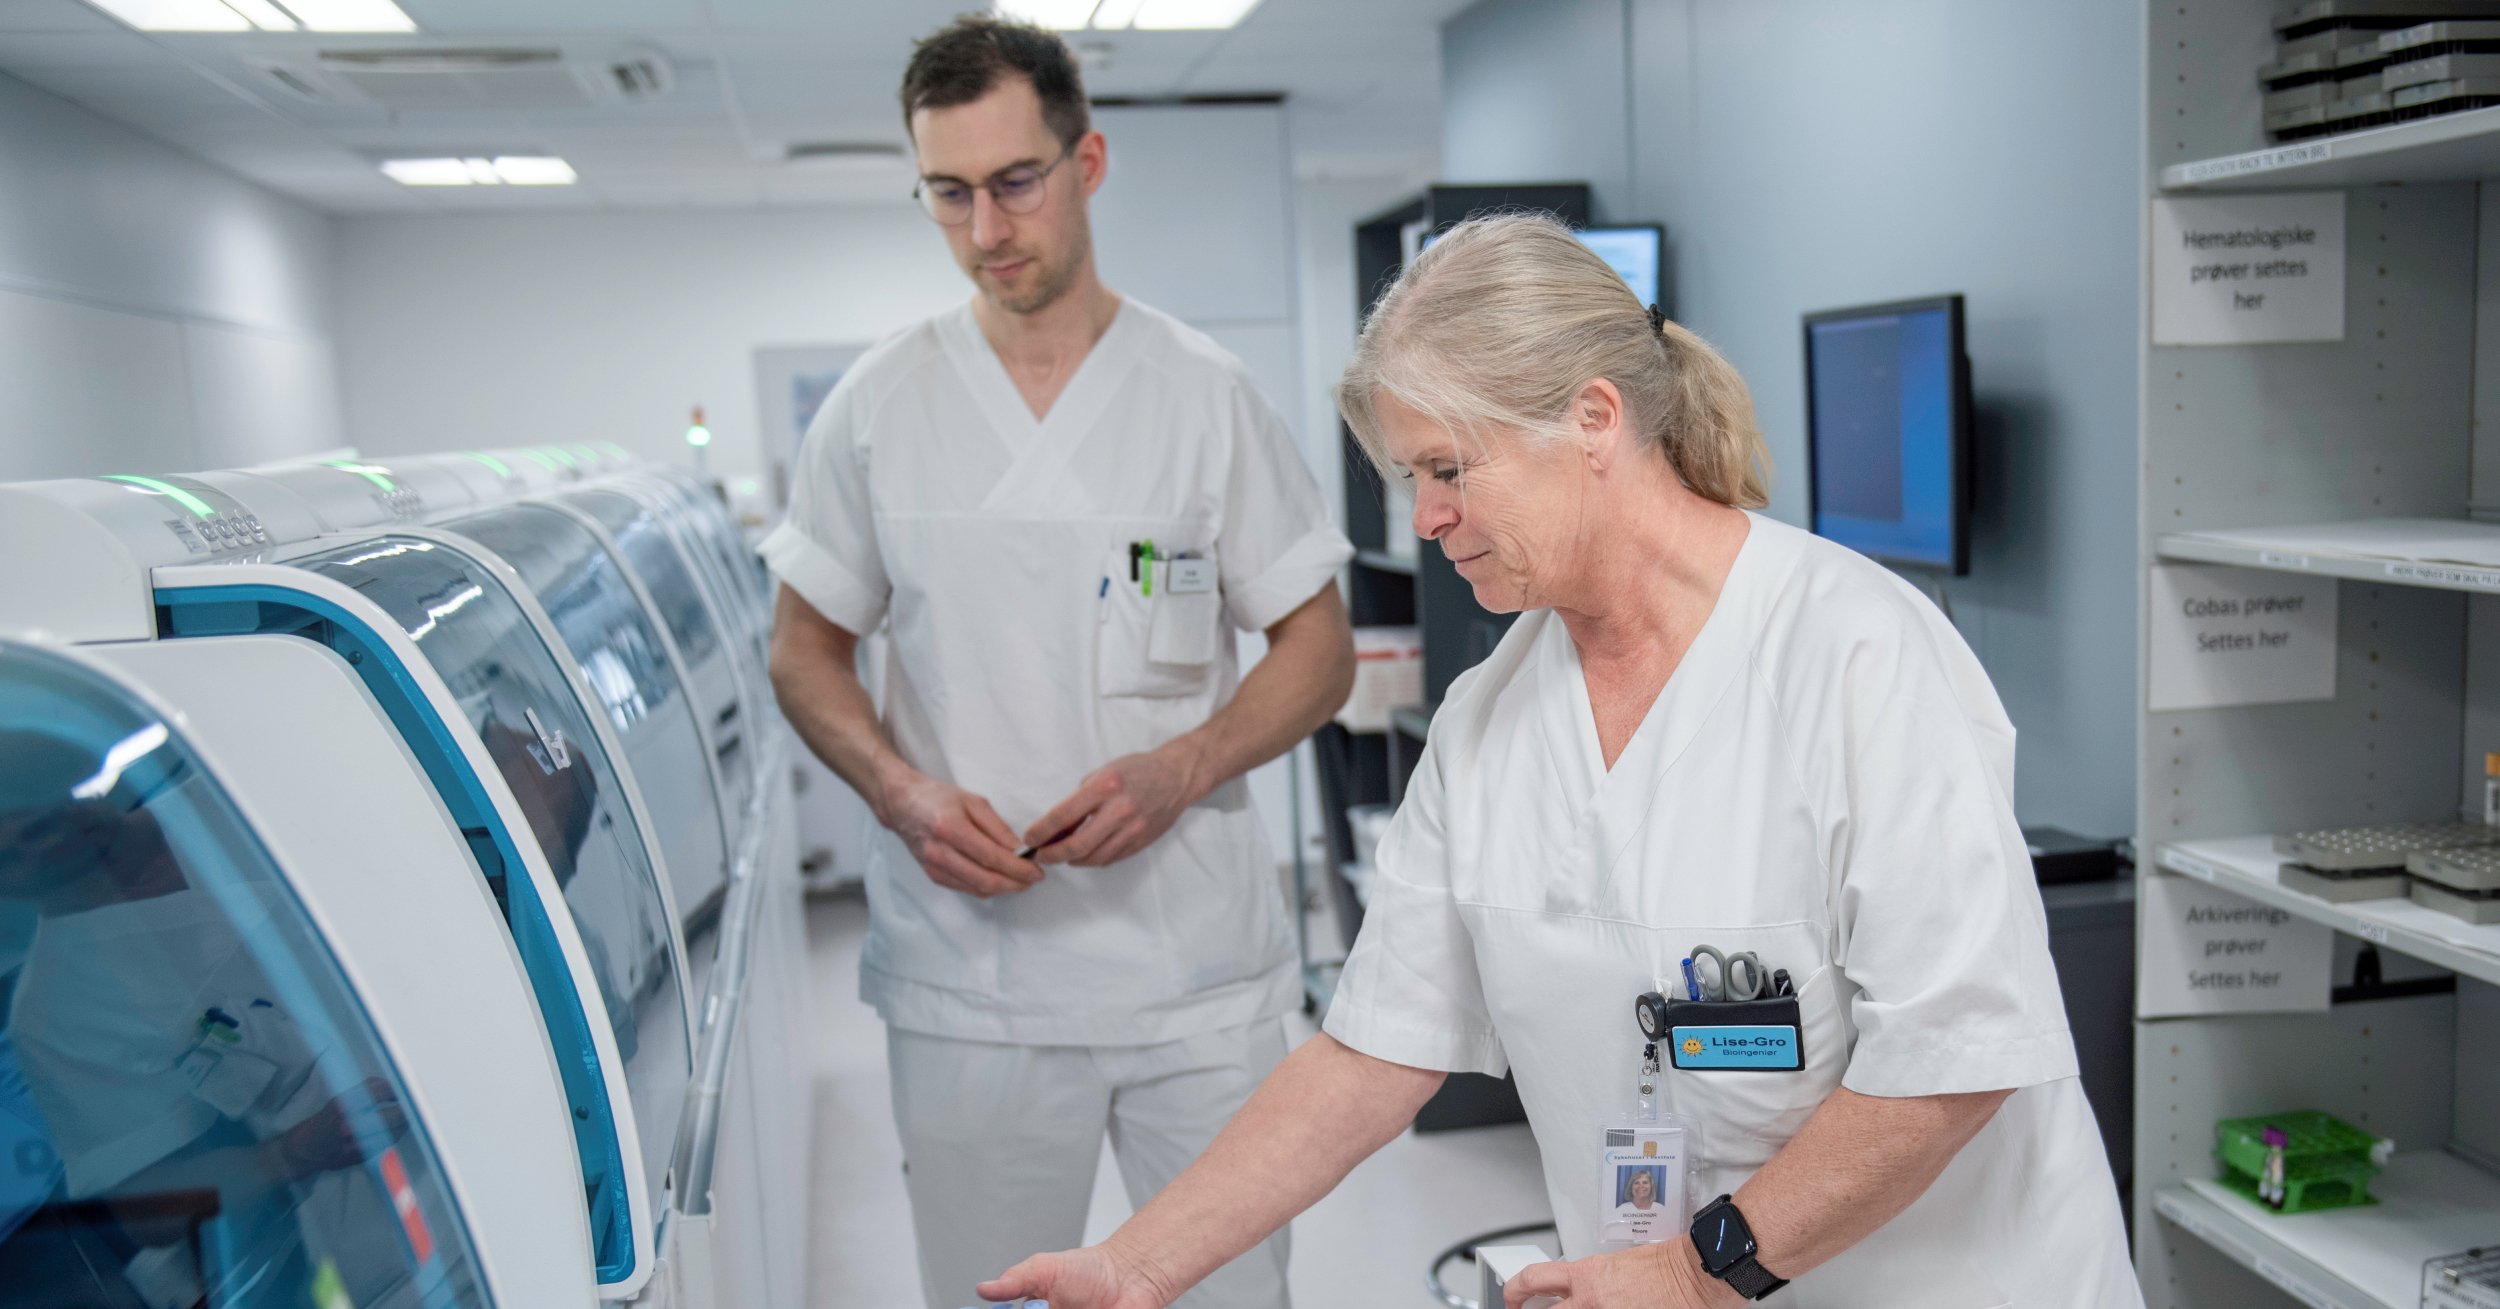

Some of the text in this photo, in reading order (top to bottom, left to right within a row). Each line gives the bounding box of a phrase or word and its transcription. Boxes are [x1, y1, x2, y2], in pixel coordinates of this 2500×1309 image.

[2183, 226, 2316, 250] Hematologiske
[2190, 260, 2308, 284] prøver settes
[2233, 289, 2264, 310] her
[2183, 596, 2304, 621] Cobas prøver
[2197, 628, 2289, 652] Settes her
[2205, 937, 2267, 957] prøver
[2187, 967, 2281, 990] Settes her
[1712, 1036, 1787, 1047] Lise-Gro
[1722, 1049, 1777, 1057] Bioingeniør
